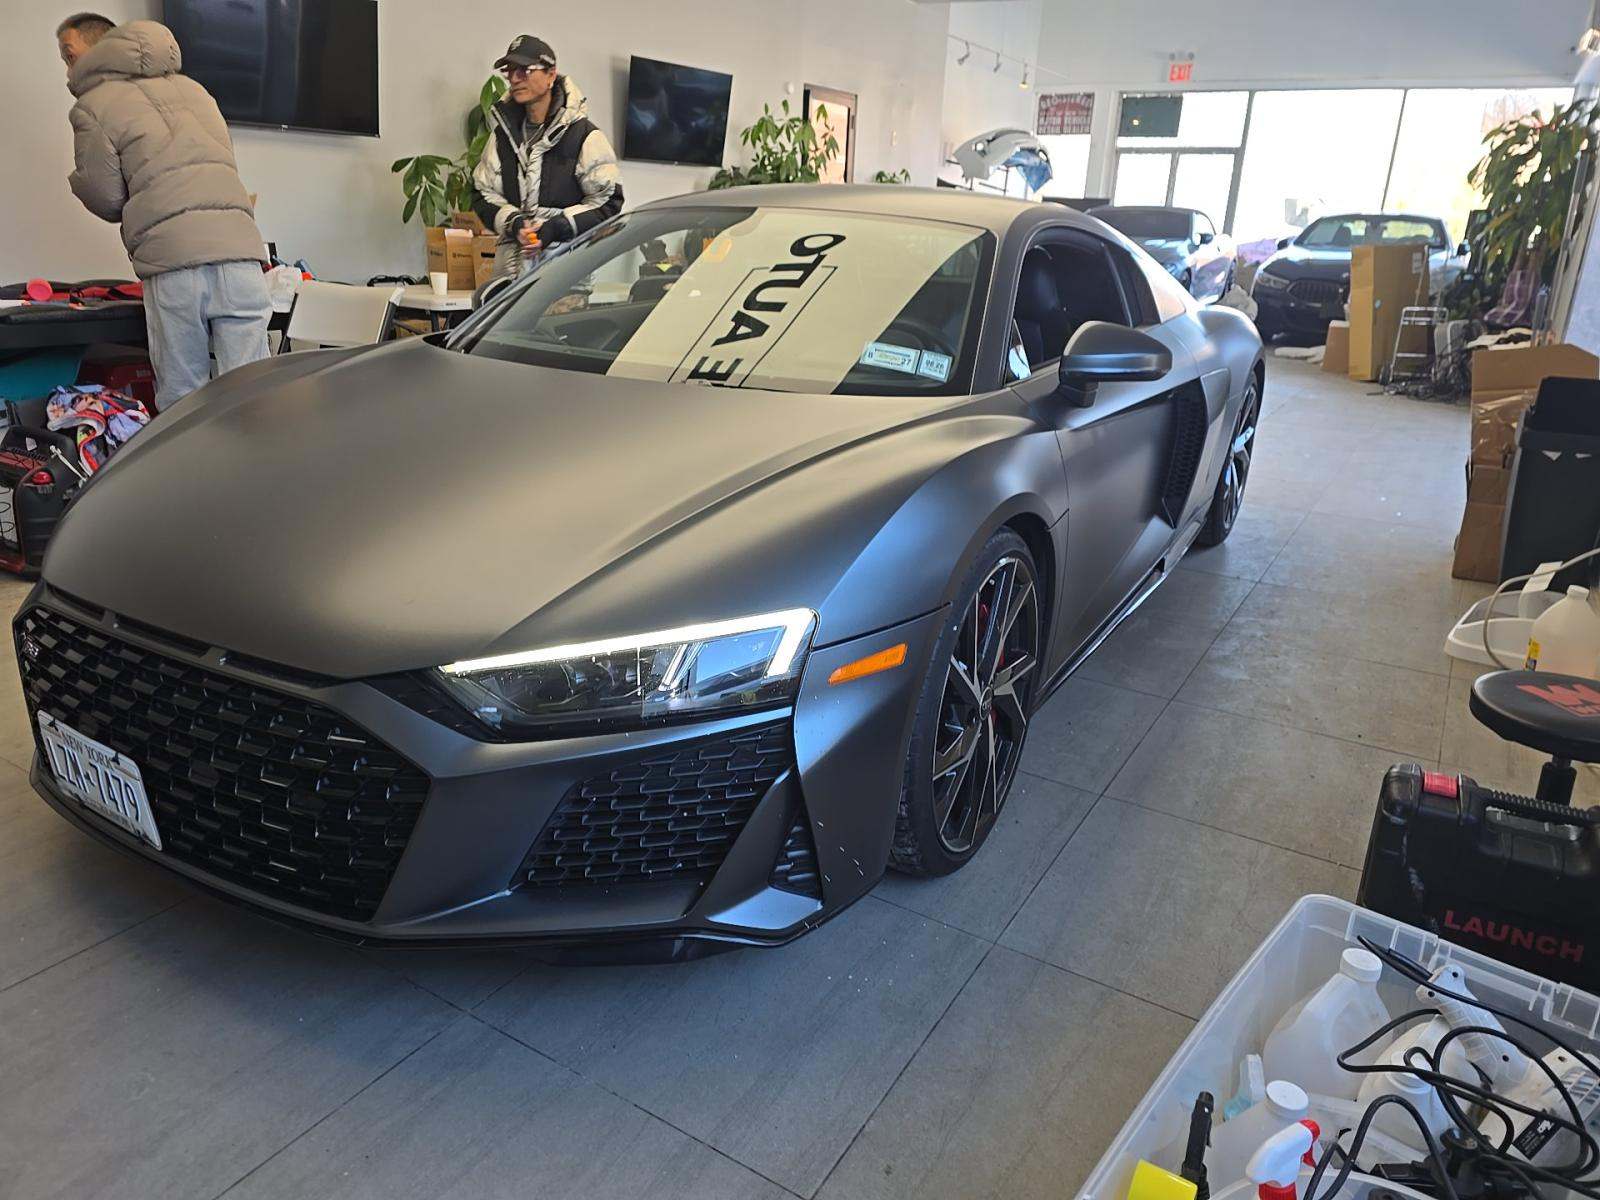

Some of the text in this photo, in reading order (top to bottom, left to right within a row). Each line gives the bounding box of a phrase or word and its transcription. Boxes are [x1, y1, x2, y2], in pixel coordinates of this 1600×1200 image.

[1169, 63, 1192, 81] EXIT
[63, 732, 113, 769] NEW YORK
[1443, 909, 1585, 963] LAUNCH
